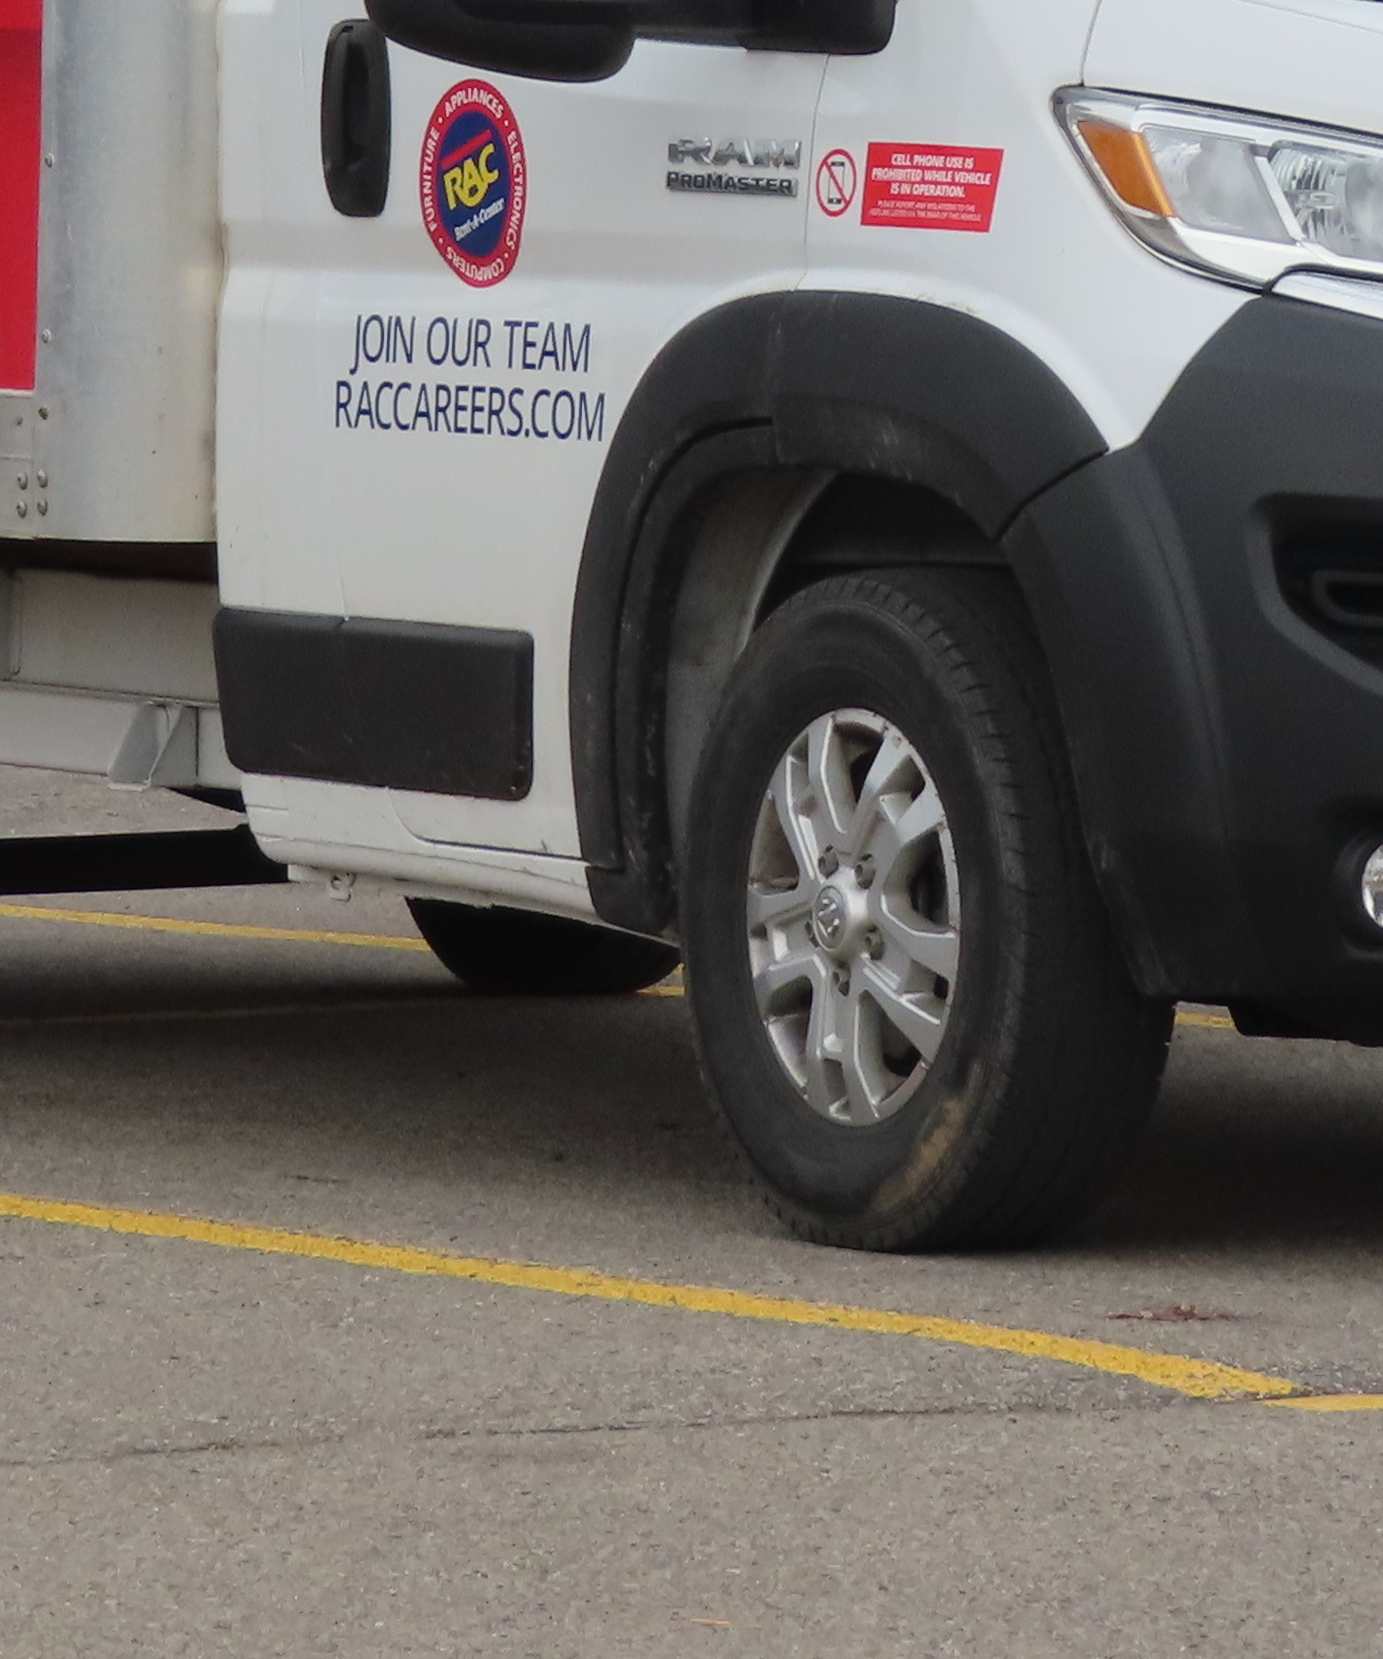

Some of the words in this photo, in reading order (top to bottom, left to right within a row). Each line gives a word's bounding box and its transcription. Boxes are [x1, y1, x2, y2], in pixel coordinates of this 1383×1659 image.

[444, 87, 506, 119] APPLIANCES
[443, 142, 500, 211] RAC
[668, 138, 803, 170] RAM
[891, 153, 911, 166] CELL
[913, 154, 945, 168] PHONE
[946, 156, 963, 169] USE
[964, 157, 974, 170] IS
[422, 125, 441, 233] FURNITURE
[505, 129, 524, 251] ELECTRONICS
[890, 182, 900, 195] IS
[901, 183, 912, 195] IN
[445, 245, 505, 282] COMPUTERS
[350, 314, 416, 375] JOIN
[426, 316, 492, 368] OUR
[503, 320, 591, 373] TEAM
[334, 380, 606, 442] RACCAREERS.COM
